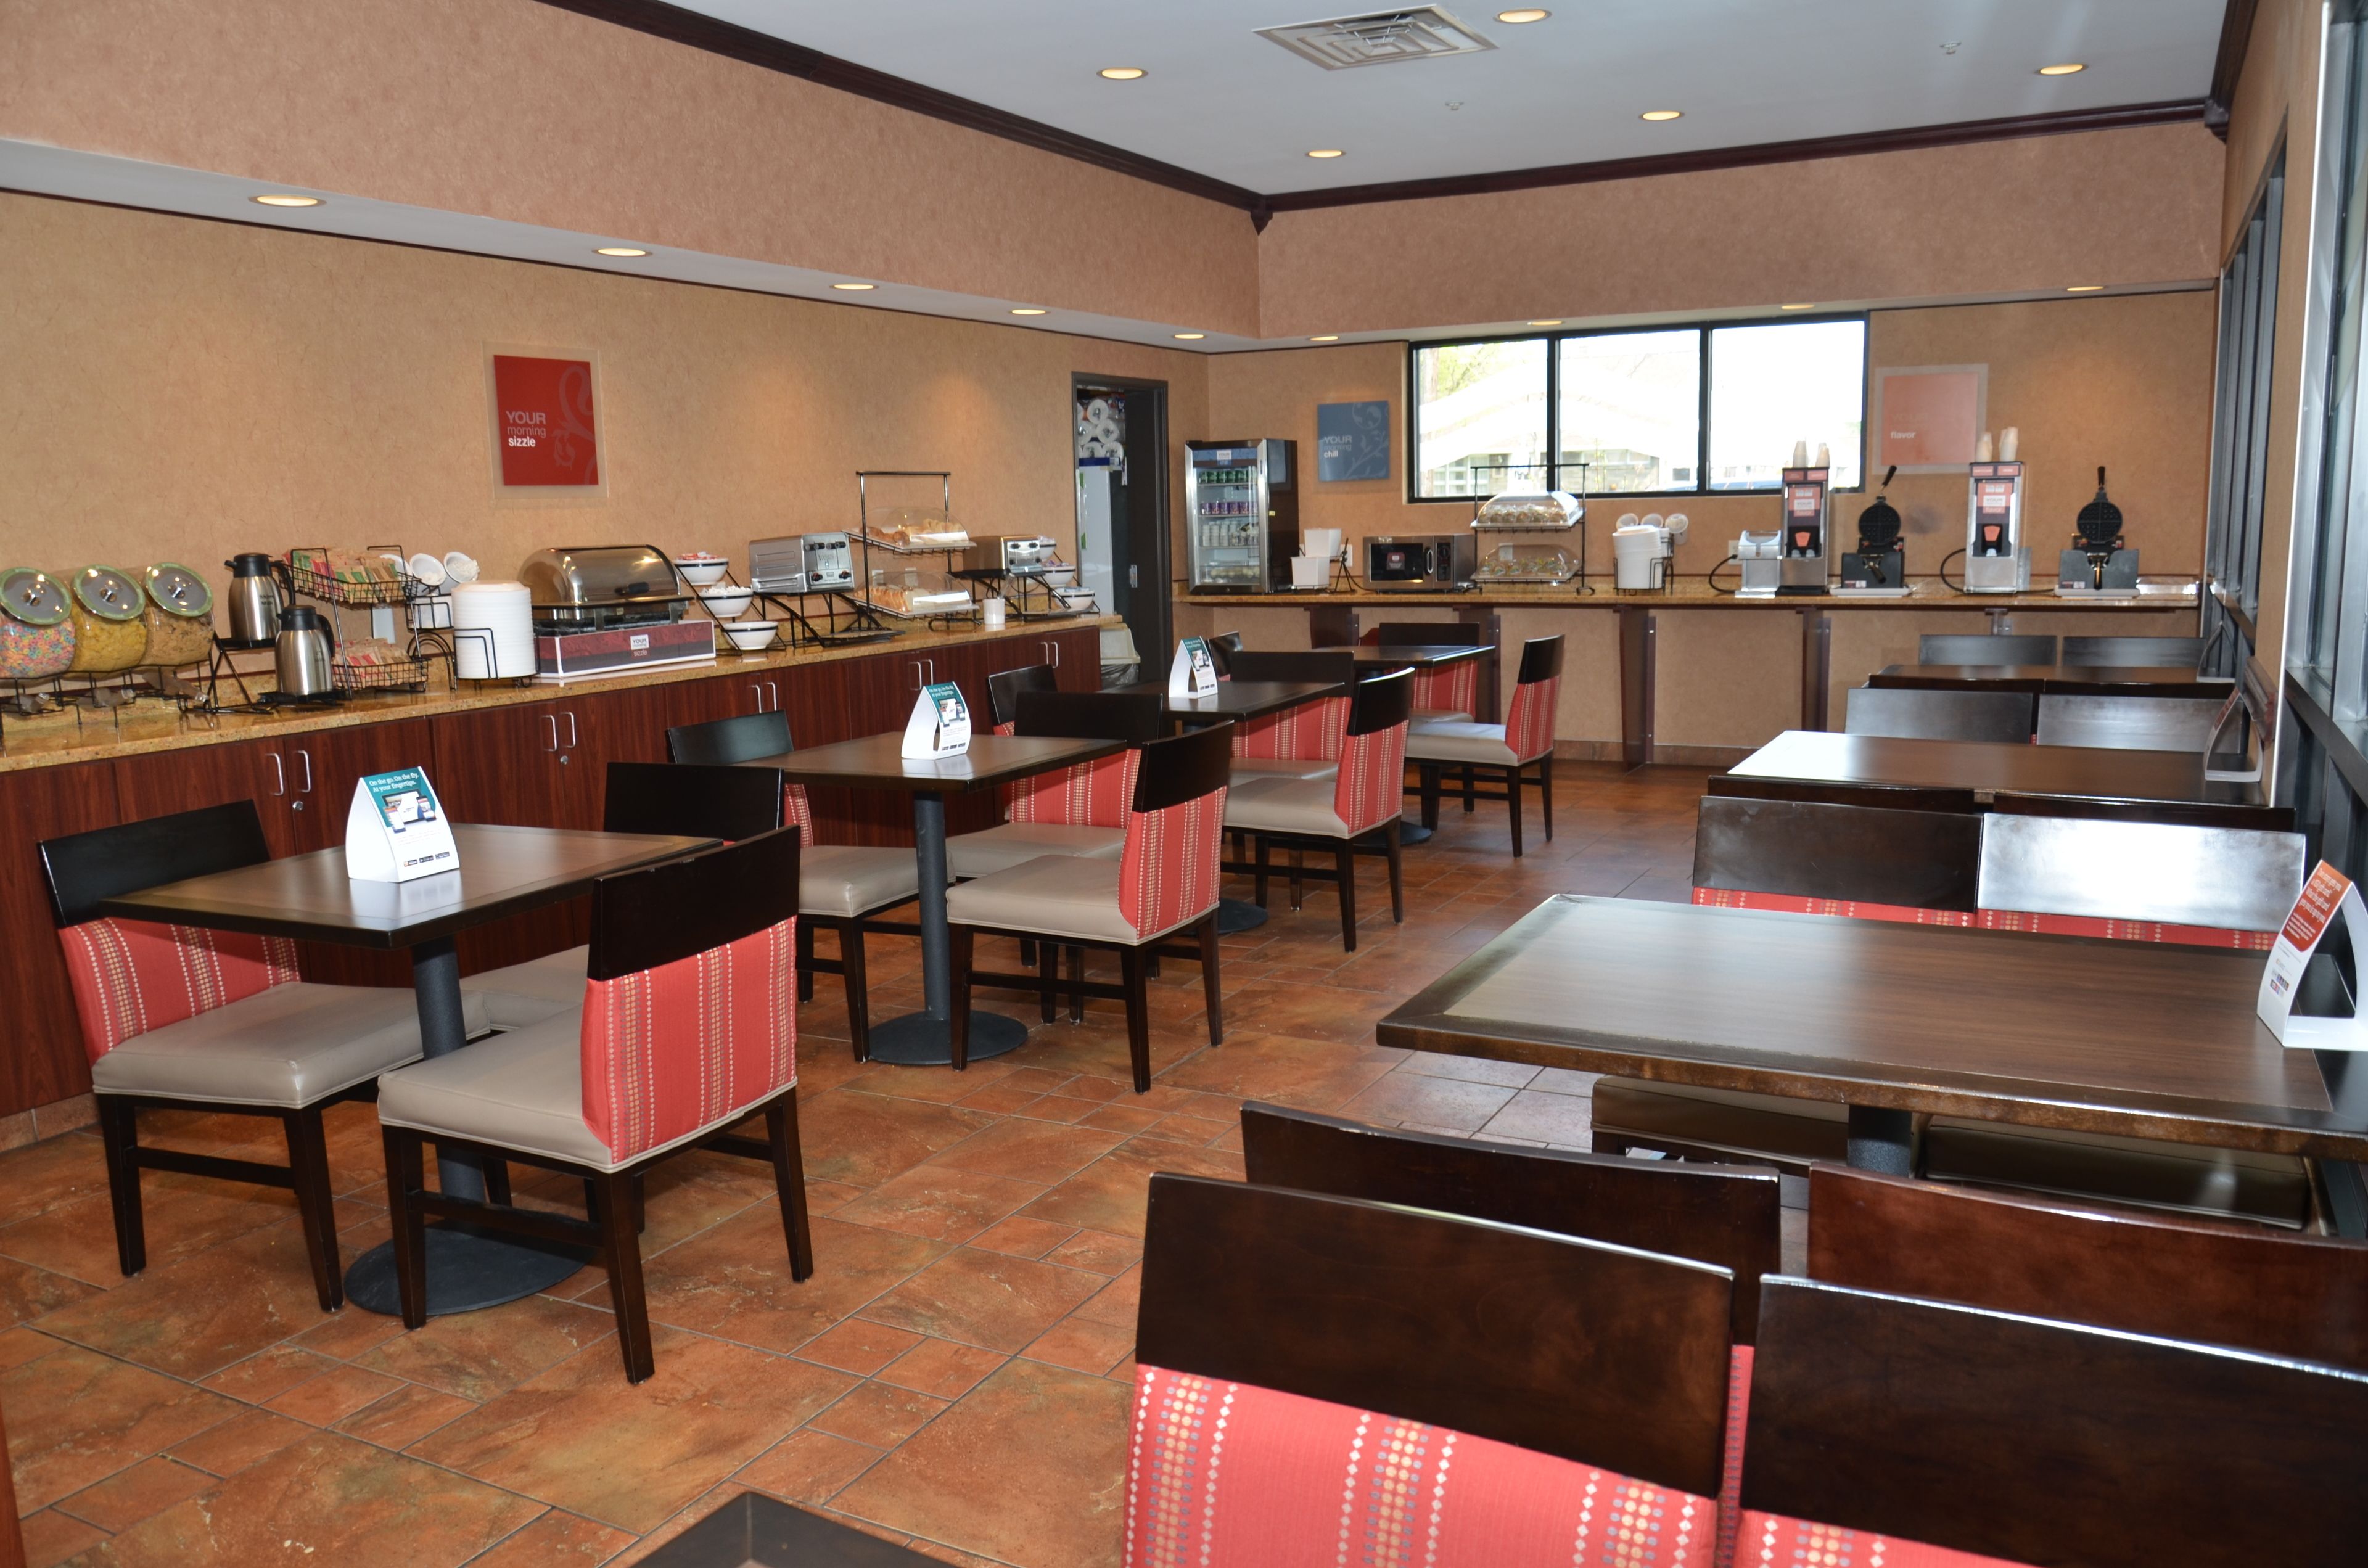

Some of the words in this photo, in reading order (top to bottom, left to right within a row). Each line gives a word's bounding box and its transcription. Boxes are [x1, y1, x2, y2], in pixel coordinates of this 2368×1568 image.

[506, 411, 546, 424] YOUR
[508, 425, 546, 438] morning
[1891, 430, 1916, 439] flavor
[508, 435, 536, 447] sizzle
[1324, 435, 1352, 444] YOUR
